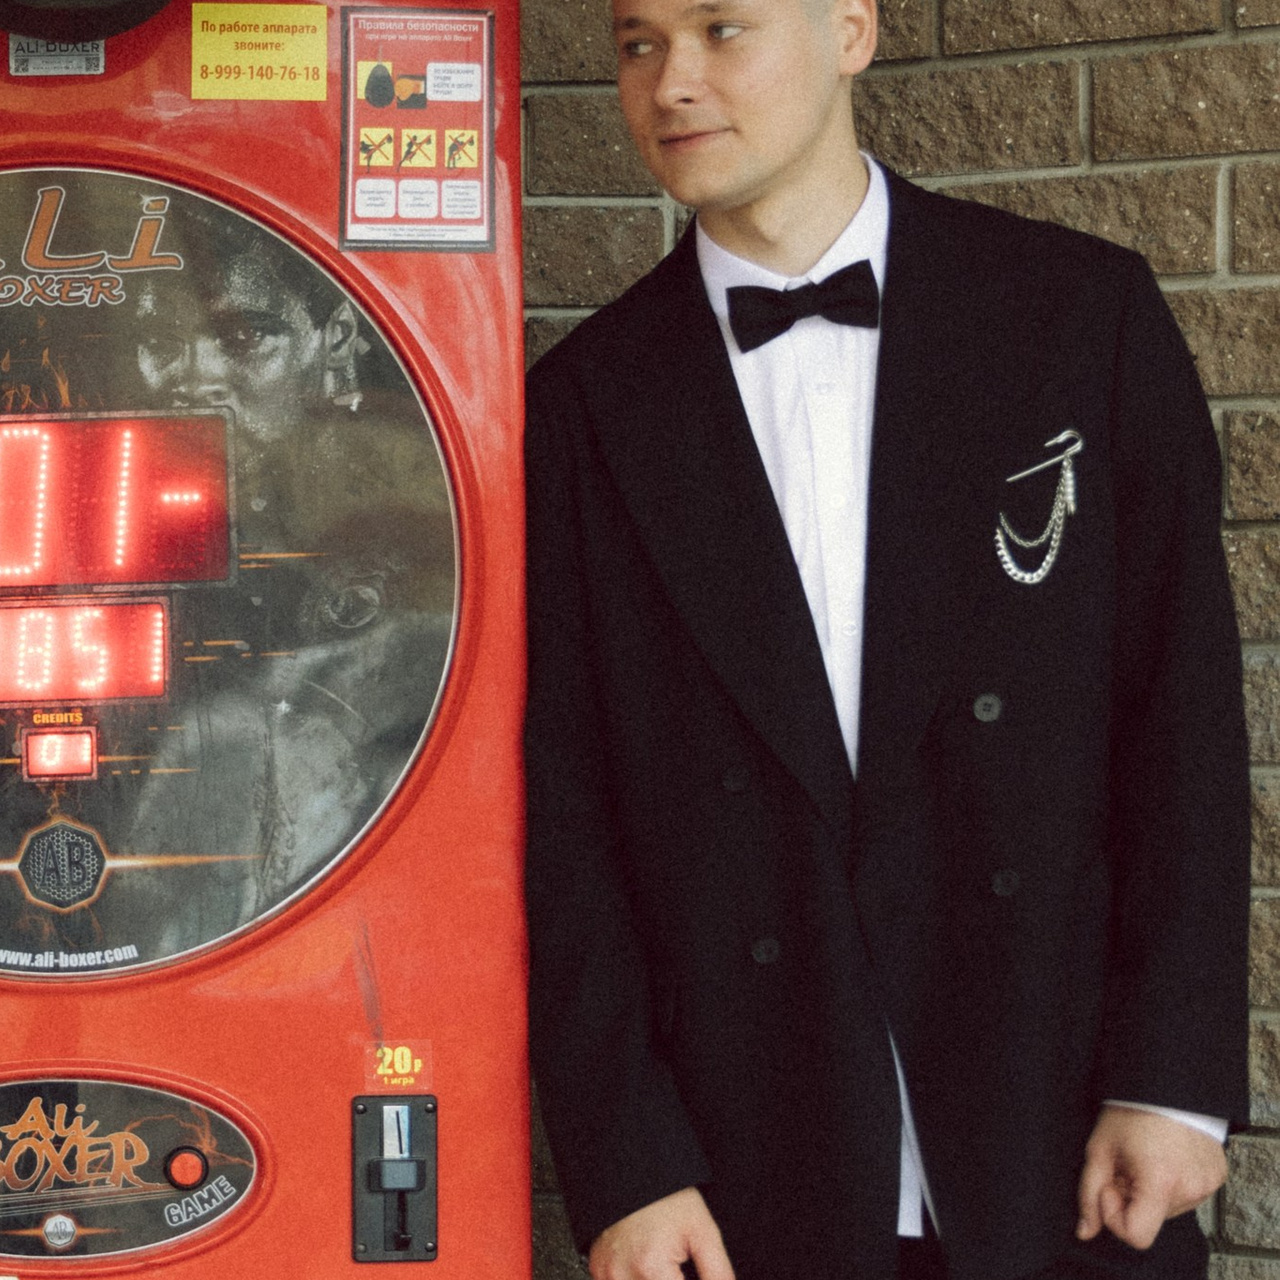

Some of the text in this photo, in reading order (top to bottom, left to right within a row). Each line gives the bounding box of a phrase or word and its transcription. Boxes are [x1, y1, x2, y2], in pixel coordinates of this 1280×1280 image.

[200, 20, 318, 37] По работе аппарата
[358, 19, 479, 33] Правила безопасности
[233, 41, 285, 52] звоните:
[200, 64, 321, 81] 8-999-140-76-18
[32, 712, 84, 725] CREDITS
[383, 1076, 415, 1087] 1 игра
[163, 1175, 236, 1227] GAME
